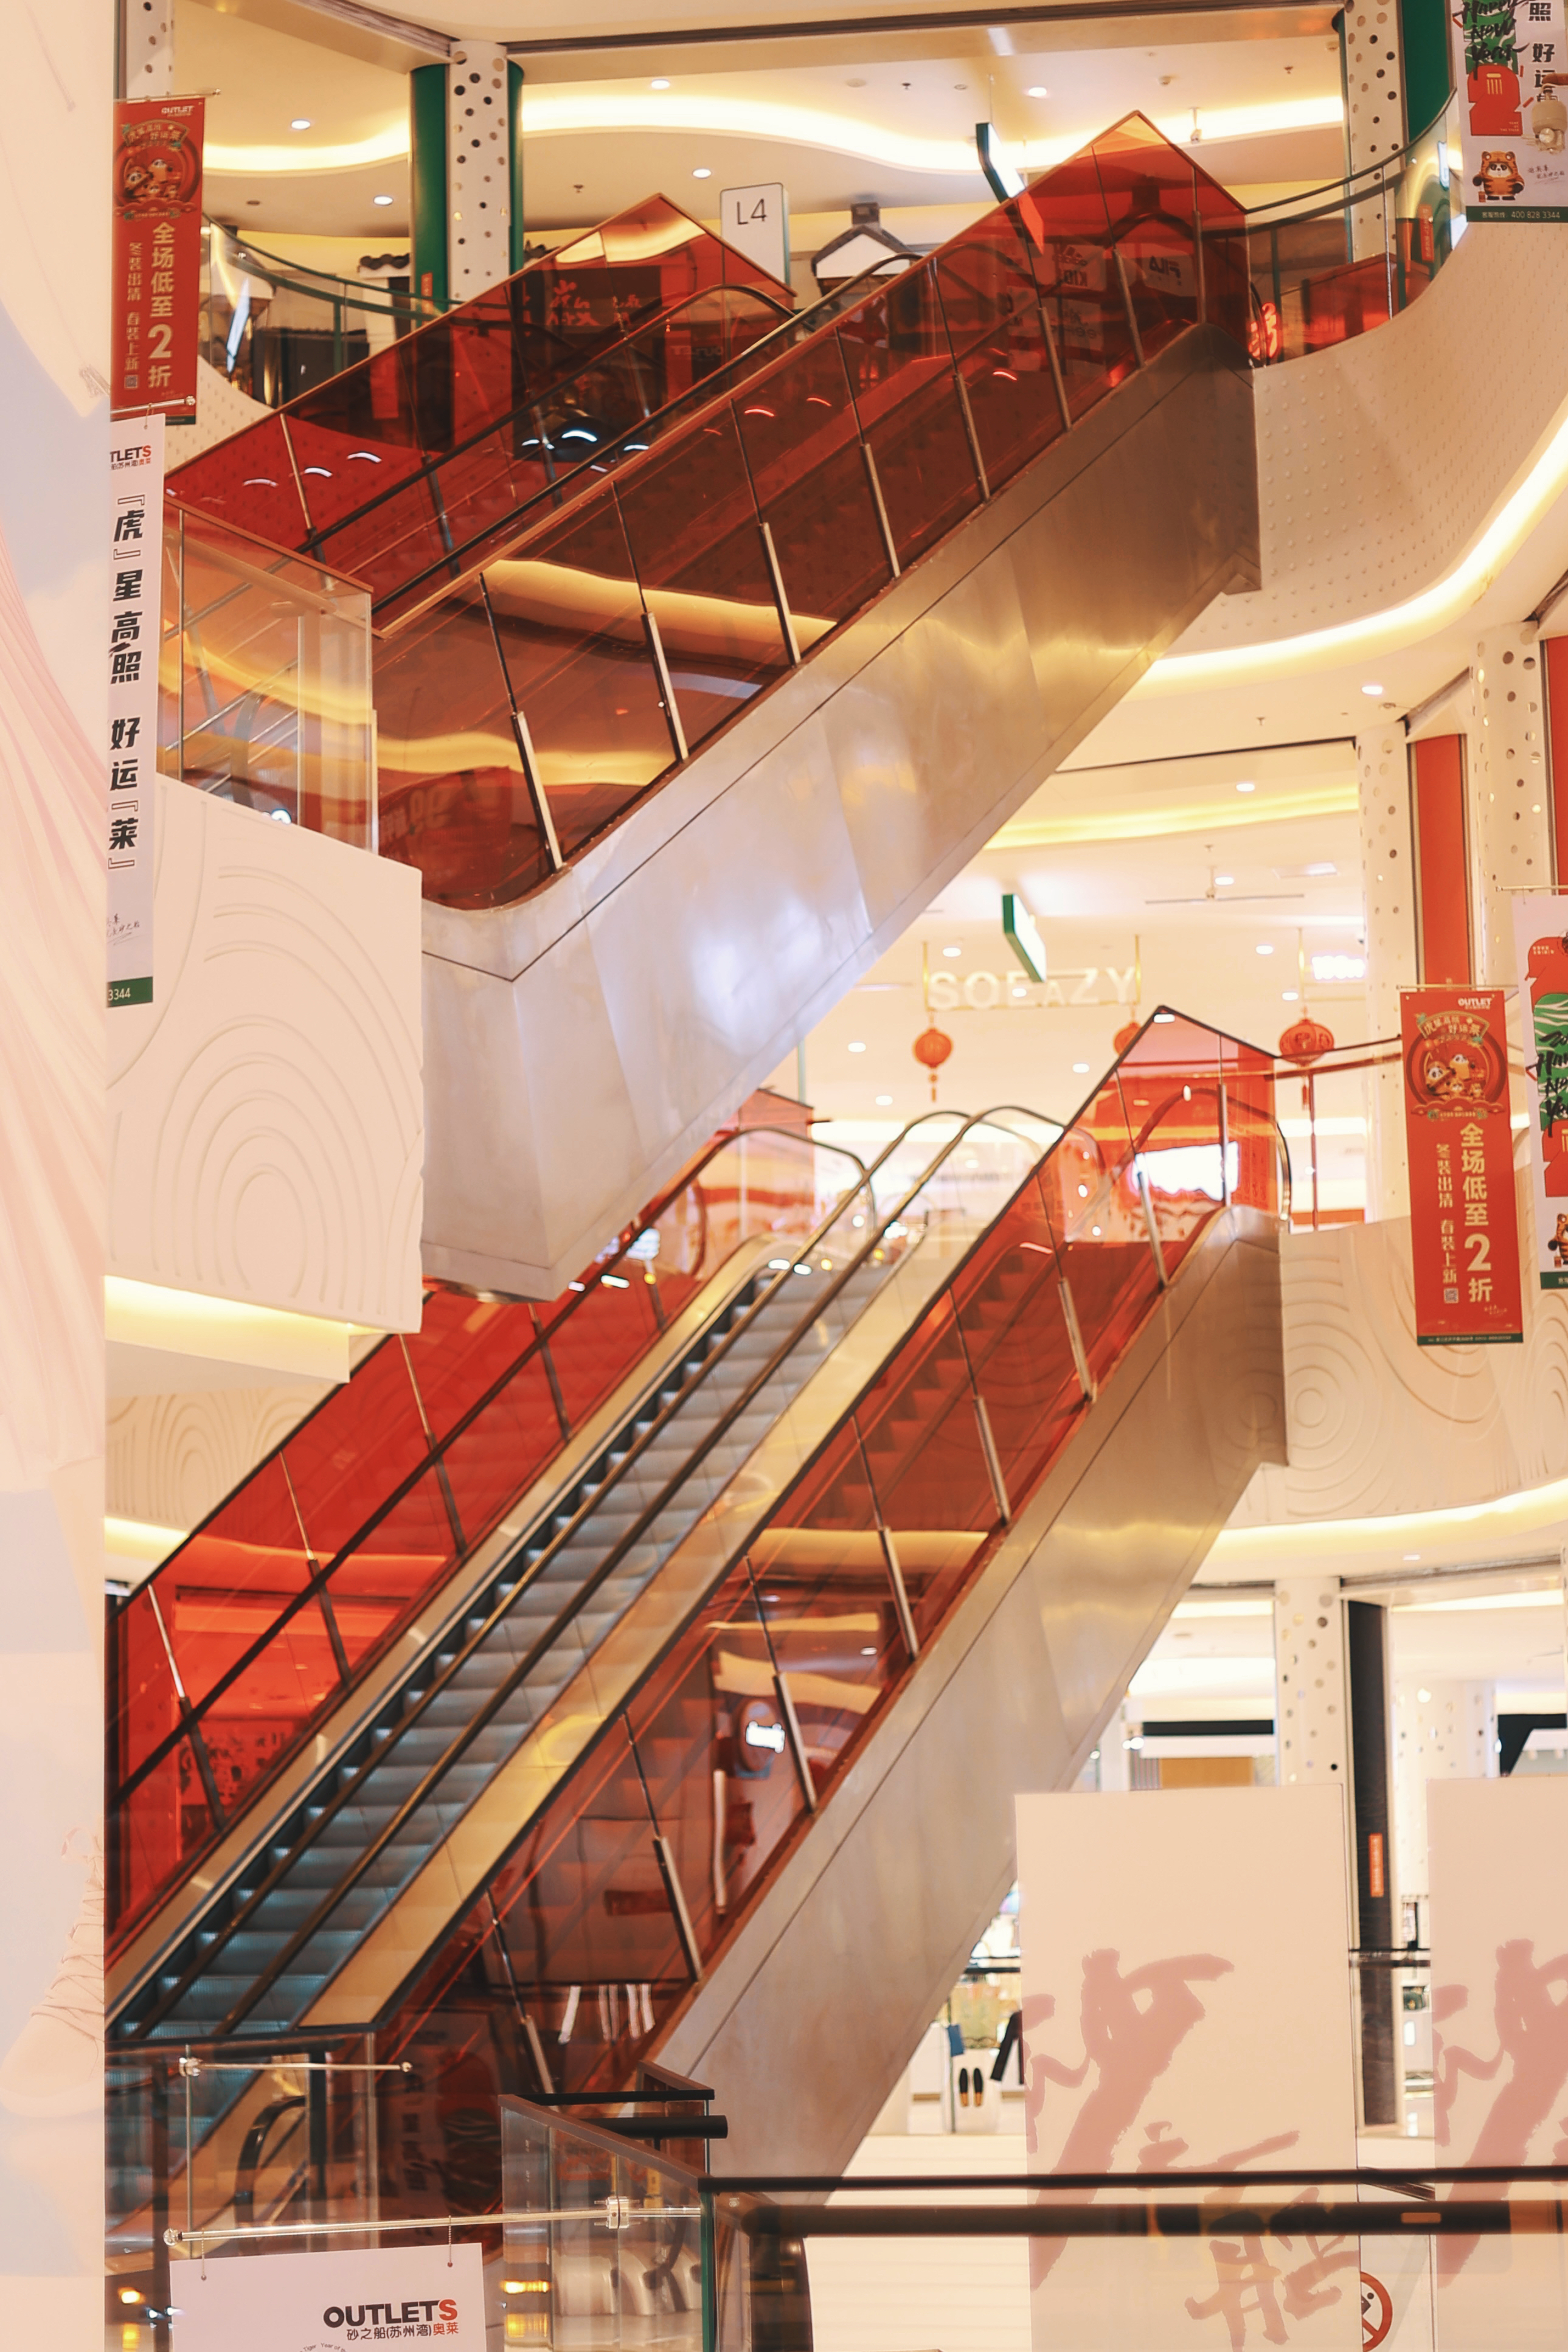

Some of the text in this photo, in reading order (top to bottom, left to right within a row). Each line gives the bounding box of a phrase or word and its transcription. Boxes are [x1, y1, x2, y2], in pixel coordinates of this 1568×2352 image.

[736, 198, 768, 226] L4
[147, 222, 176, 388] 全场低至2折
[108, 988, 131, 1001] 3344
[1460, 1122, 1493, 1303] 全场低至2折
[323, 2298, 458, 2328] OUTLETS
